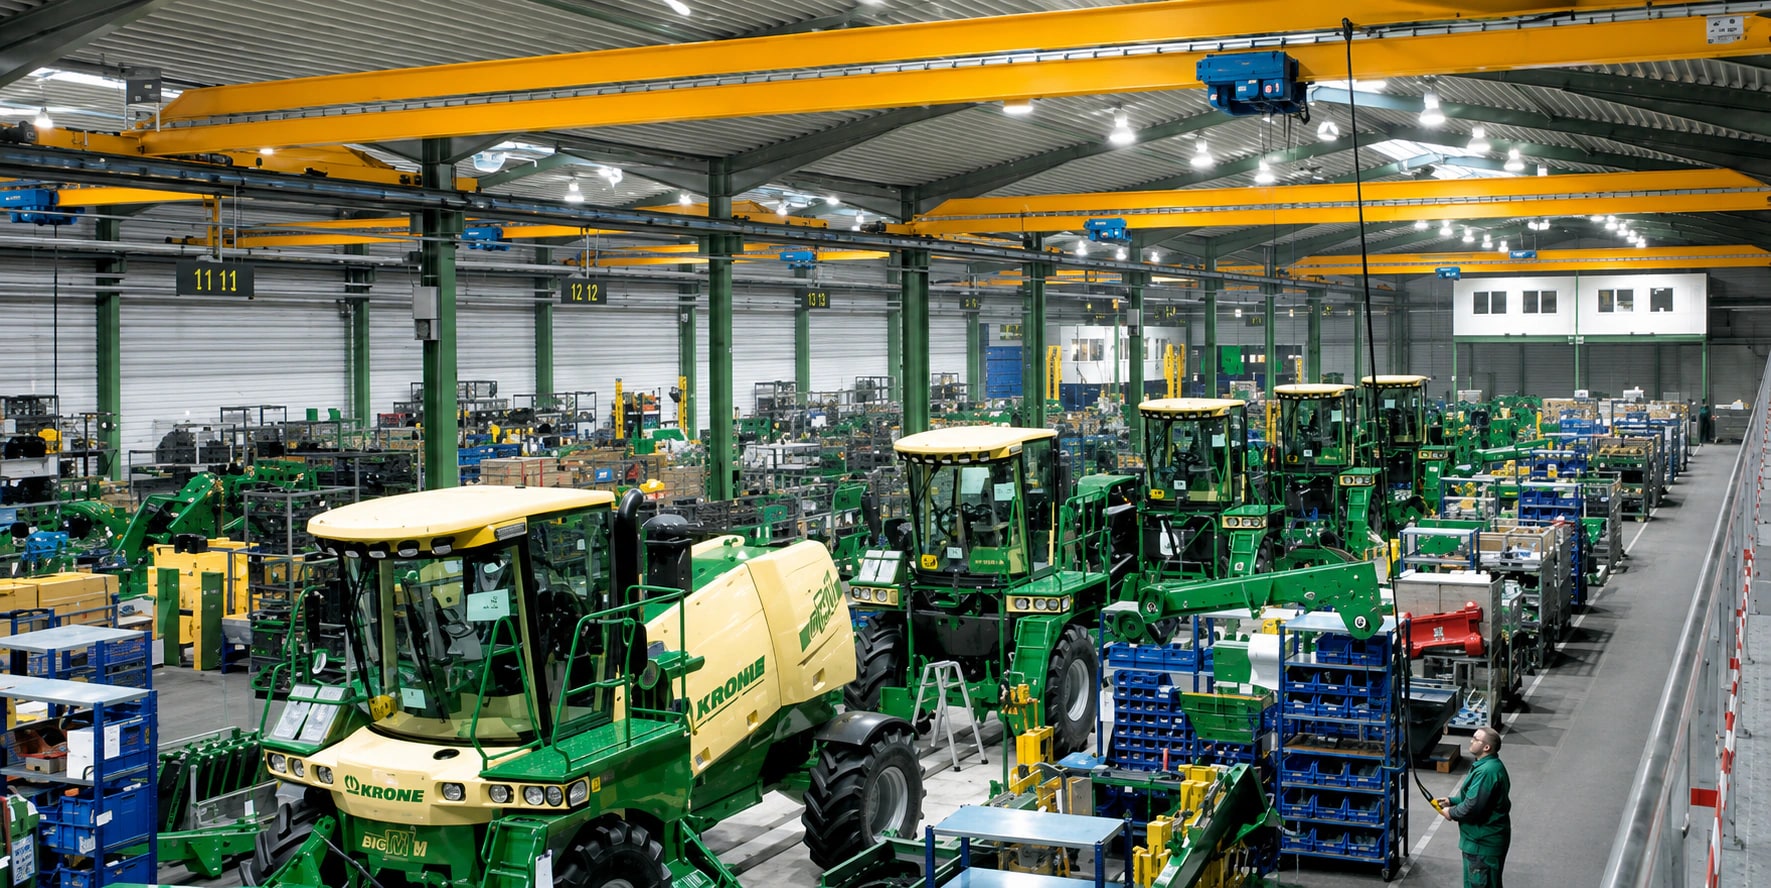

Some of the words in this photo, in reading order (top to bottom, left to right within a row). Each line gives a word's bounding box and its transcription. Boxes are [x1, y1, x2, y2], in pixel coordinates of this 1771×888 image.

[194, 267, 212, 291] 11
[219, 269, 237, 292] 11
[571, 283, 583, 301] 12
[586, 284, 598, 302] 12
[361, 784, 425, 803] KRONE
[361, 835, 387, 851] BIG
